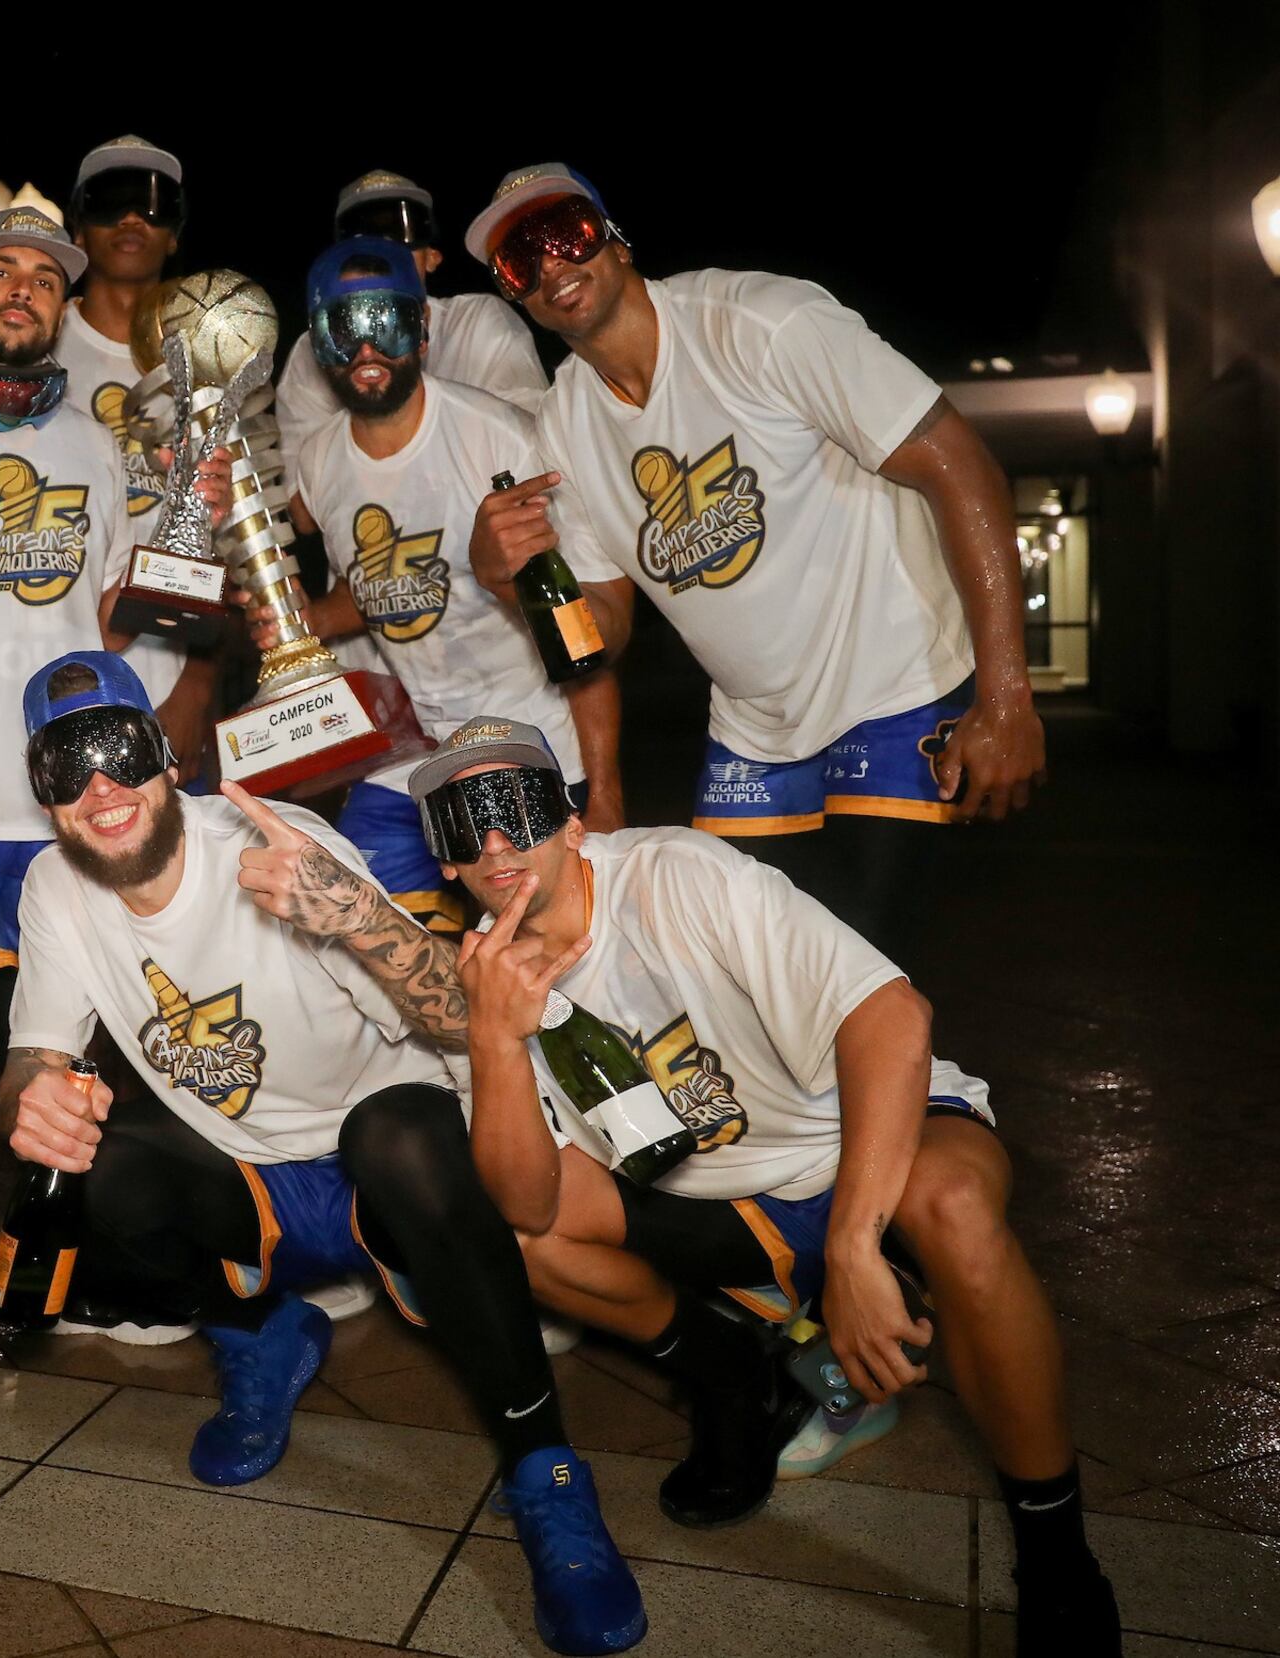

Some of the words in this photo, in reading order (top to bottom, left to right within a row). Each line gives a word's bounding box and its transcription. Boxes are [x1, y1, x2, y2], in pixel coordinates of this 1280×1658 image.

[643, 474, 757, 577] CAMPEONES
[671, 518, 763, 577] VAQUEROS
[672, 578, 699, 595] 2020
[269, 693, 334, 727] CAMPEÓN
[289, 723, 313, 742] 2020
[708, 782, 766, 793] SEGUROS
[703, 792, 771, 803] MULTIPLES
